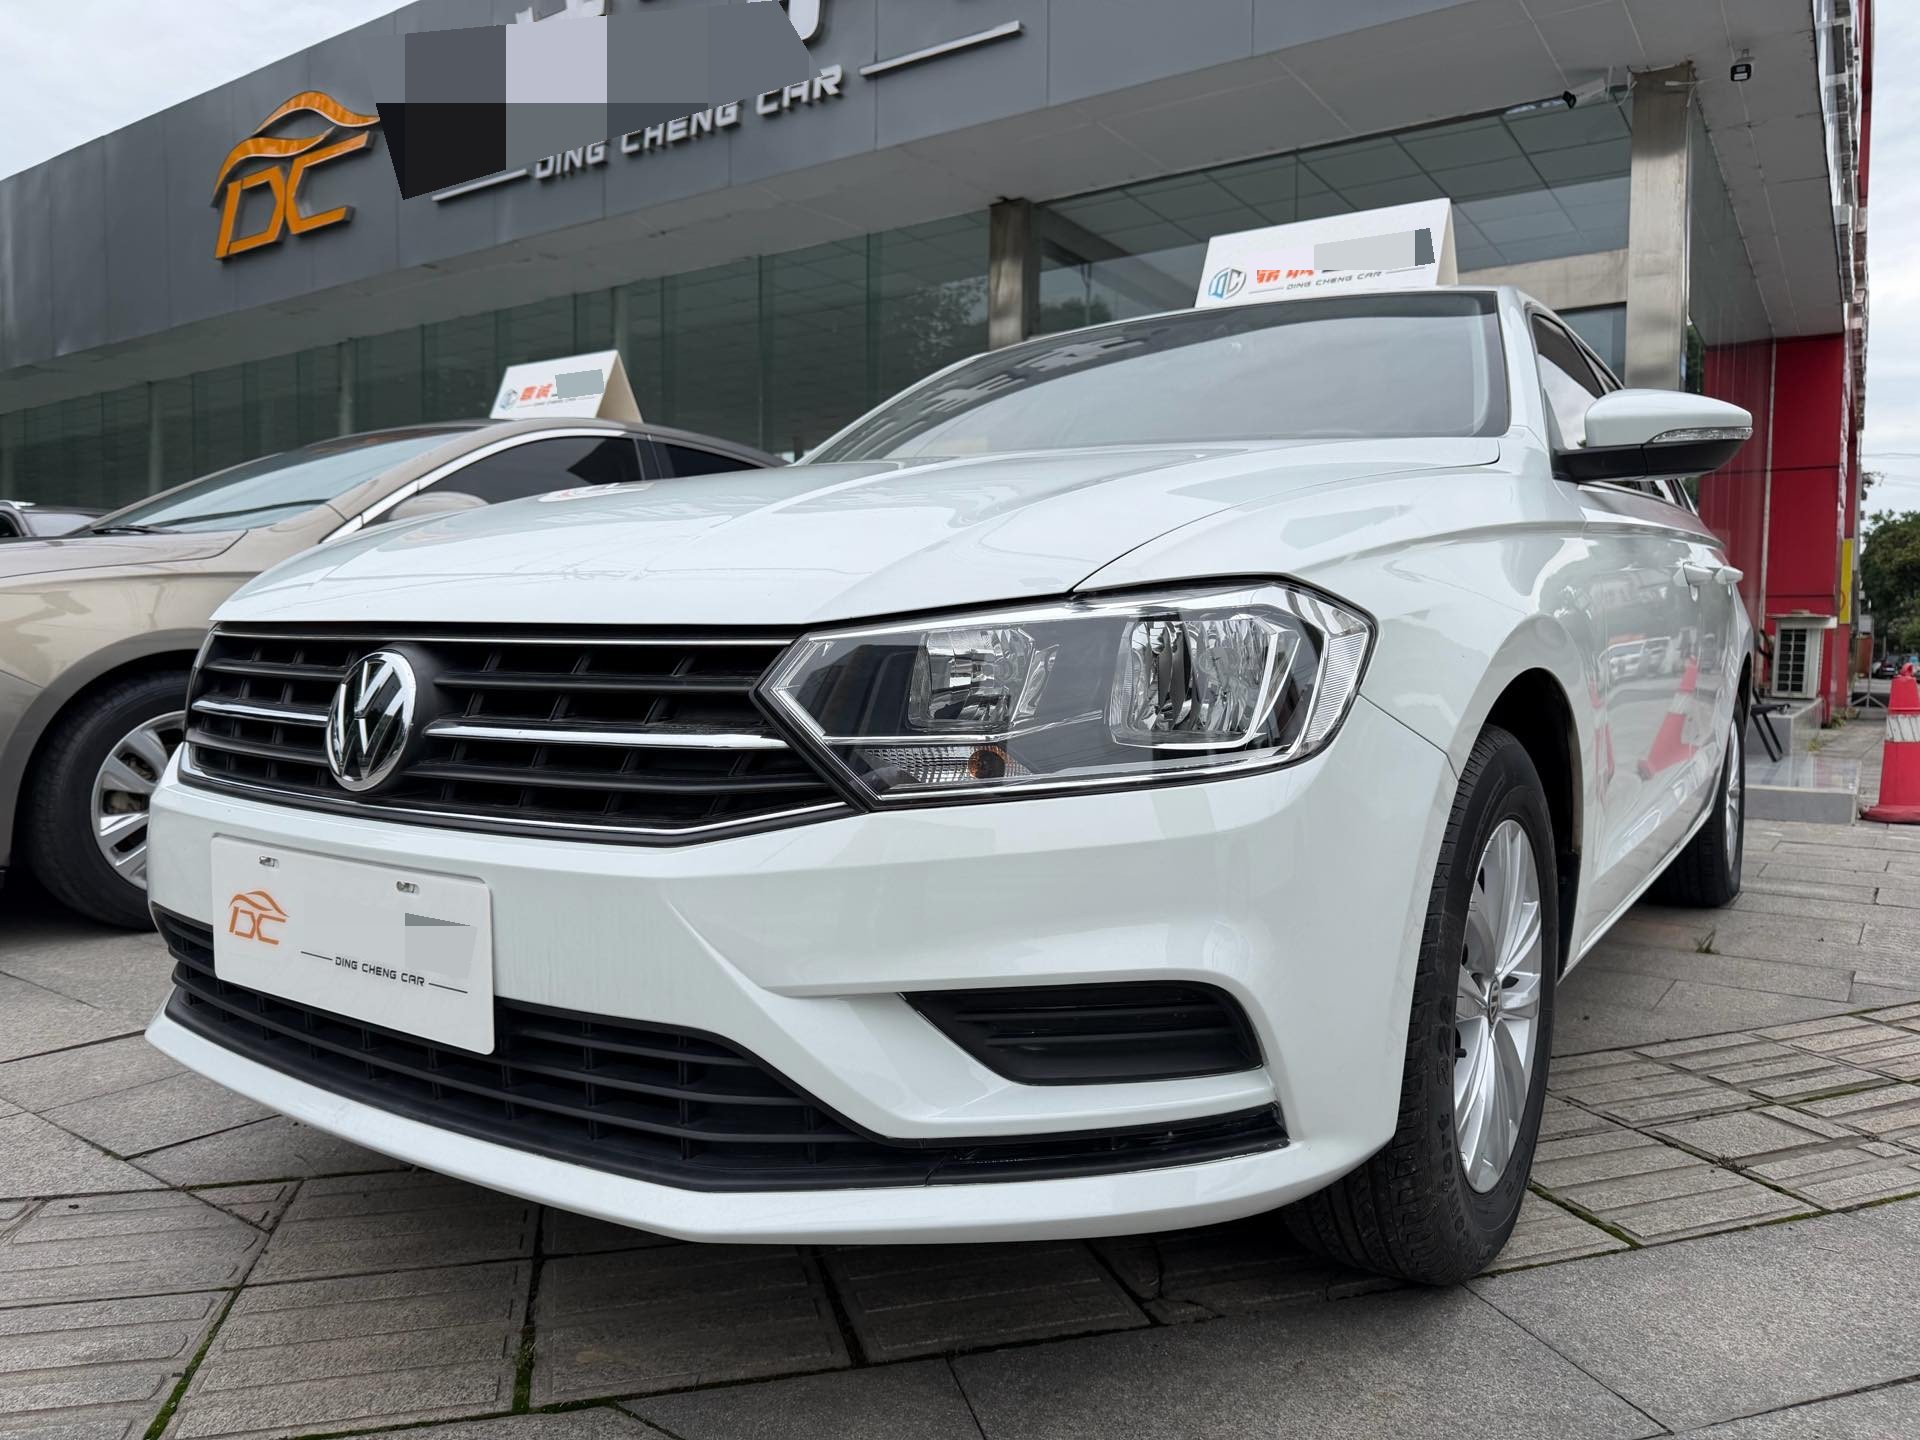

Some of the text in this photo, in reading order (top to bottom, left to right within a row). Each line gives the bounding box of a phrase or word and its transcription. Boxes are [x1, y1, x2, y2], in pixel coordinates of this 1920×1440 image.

[535, 64, 843, 179] DING CHENG CAR
[1286, 281, 1312, 290] DING
[1315, 275, 1353, 286] CHENG
[1356, 271, 1382, 280] CAR
[334, 956, 426, 987] DING CHENG CAR
